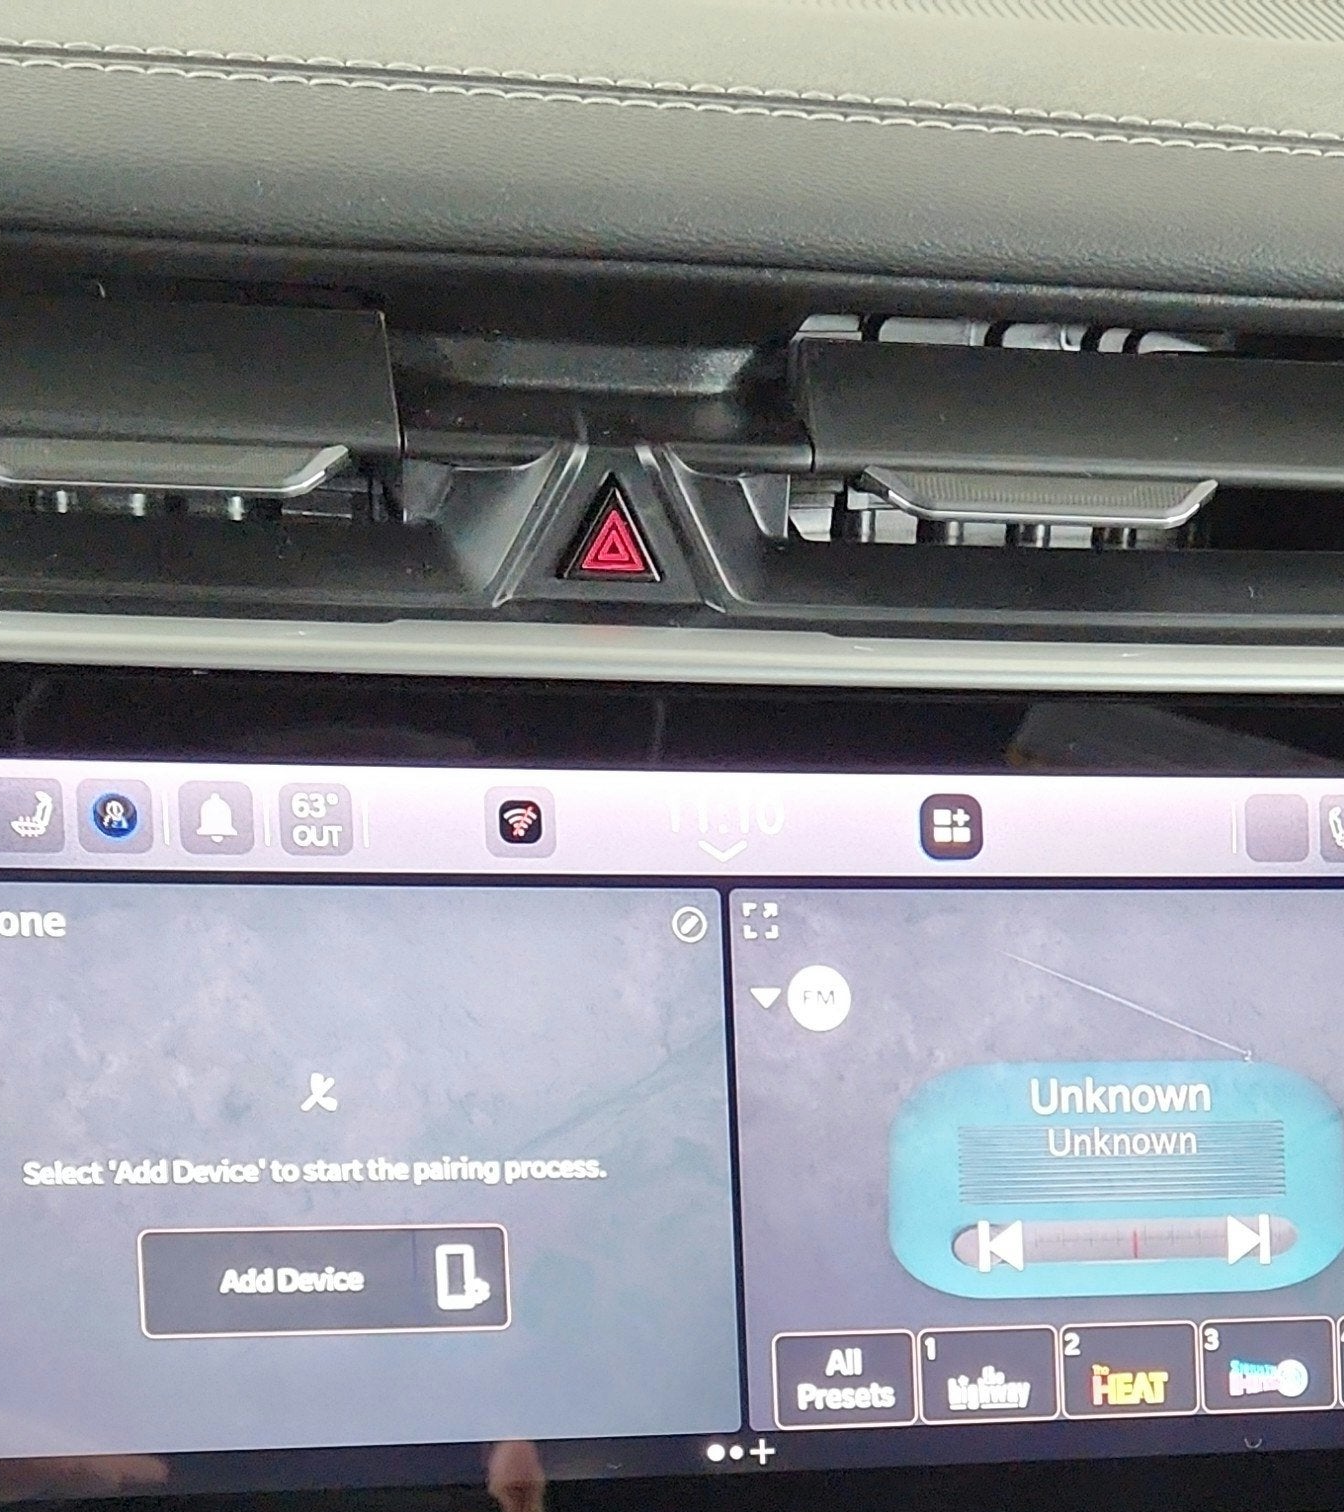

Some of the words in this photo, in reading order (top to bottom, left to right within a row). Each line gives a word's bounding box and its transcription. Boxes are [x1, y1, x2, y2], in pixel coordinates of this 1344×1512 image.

[291, 791, 340, 819] 63°
[292, 824, 343, 848] OUT
[803, 990, 836, 1006] FM
[1029, 1076, 1213, 1116] Unknown
[1047, 1126, 1199, 1158] Unknown
[22, 1160, 105, 1185] Select
[269, 1161, 301, 1183] to
[303, 1159, 364, 1182] start
[367, 1156, 410, 1181] the
[413, 1156, 501, 1186] pairing
[504, 1158, 608, 1185] process.
[219, 1267, 275, 1294] Add
[277, 1266, 365, 1294] Device
[923, 1336, 936, 1361] 1
[1063, 1331, 1082, 1357] 2
[1203, 1327, 1221, 1351] 3
[824, 1347, 863, 1377] All
[796, 1381, 896, 1411] Presets
[1092, 1370, 1170, 1406] HEAT
